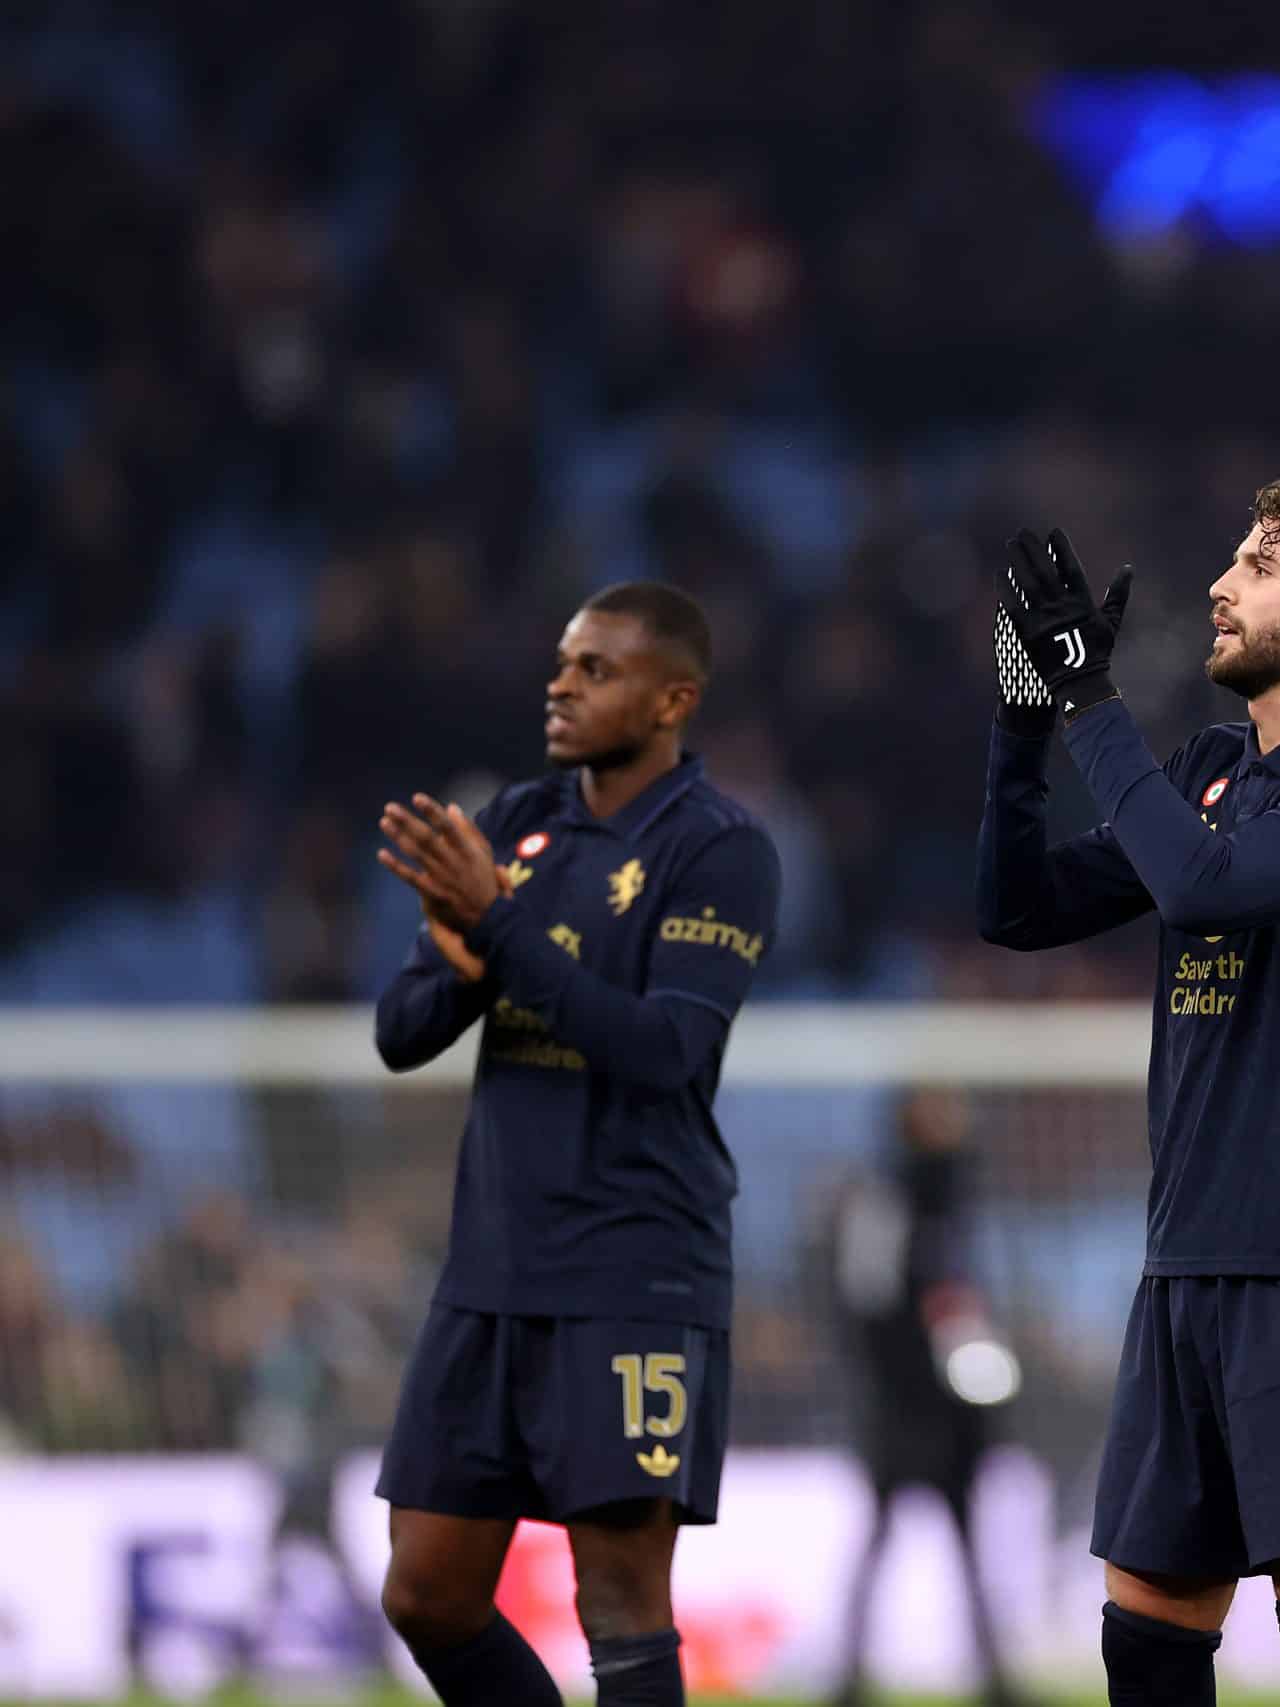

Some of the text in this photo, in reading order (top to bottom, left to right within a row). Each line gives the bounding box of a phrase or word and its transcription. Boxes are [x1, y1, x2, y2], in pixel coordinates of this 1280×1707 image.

[660, 904, 764, 964] azimut
[1174, 951, 1245, 980] Save th
[611, 1351, 688, 1439] 15
